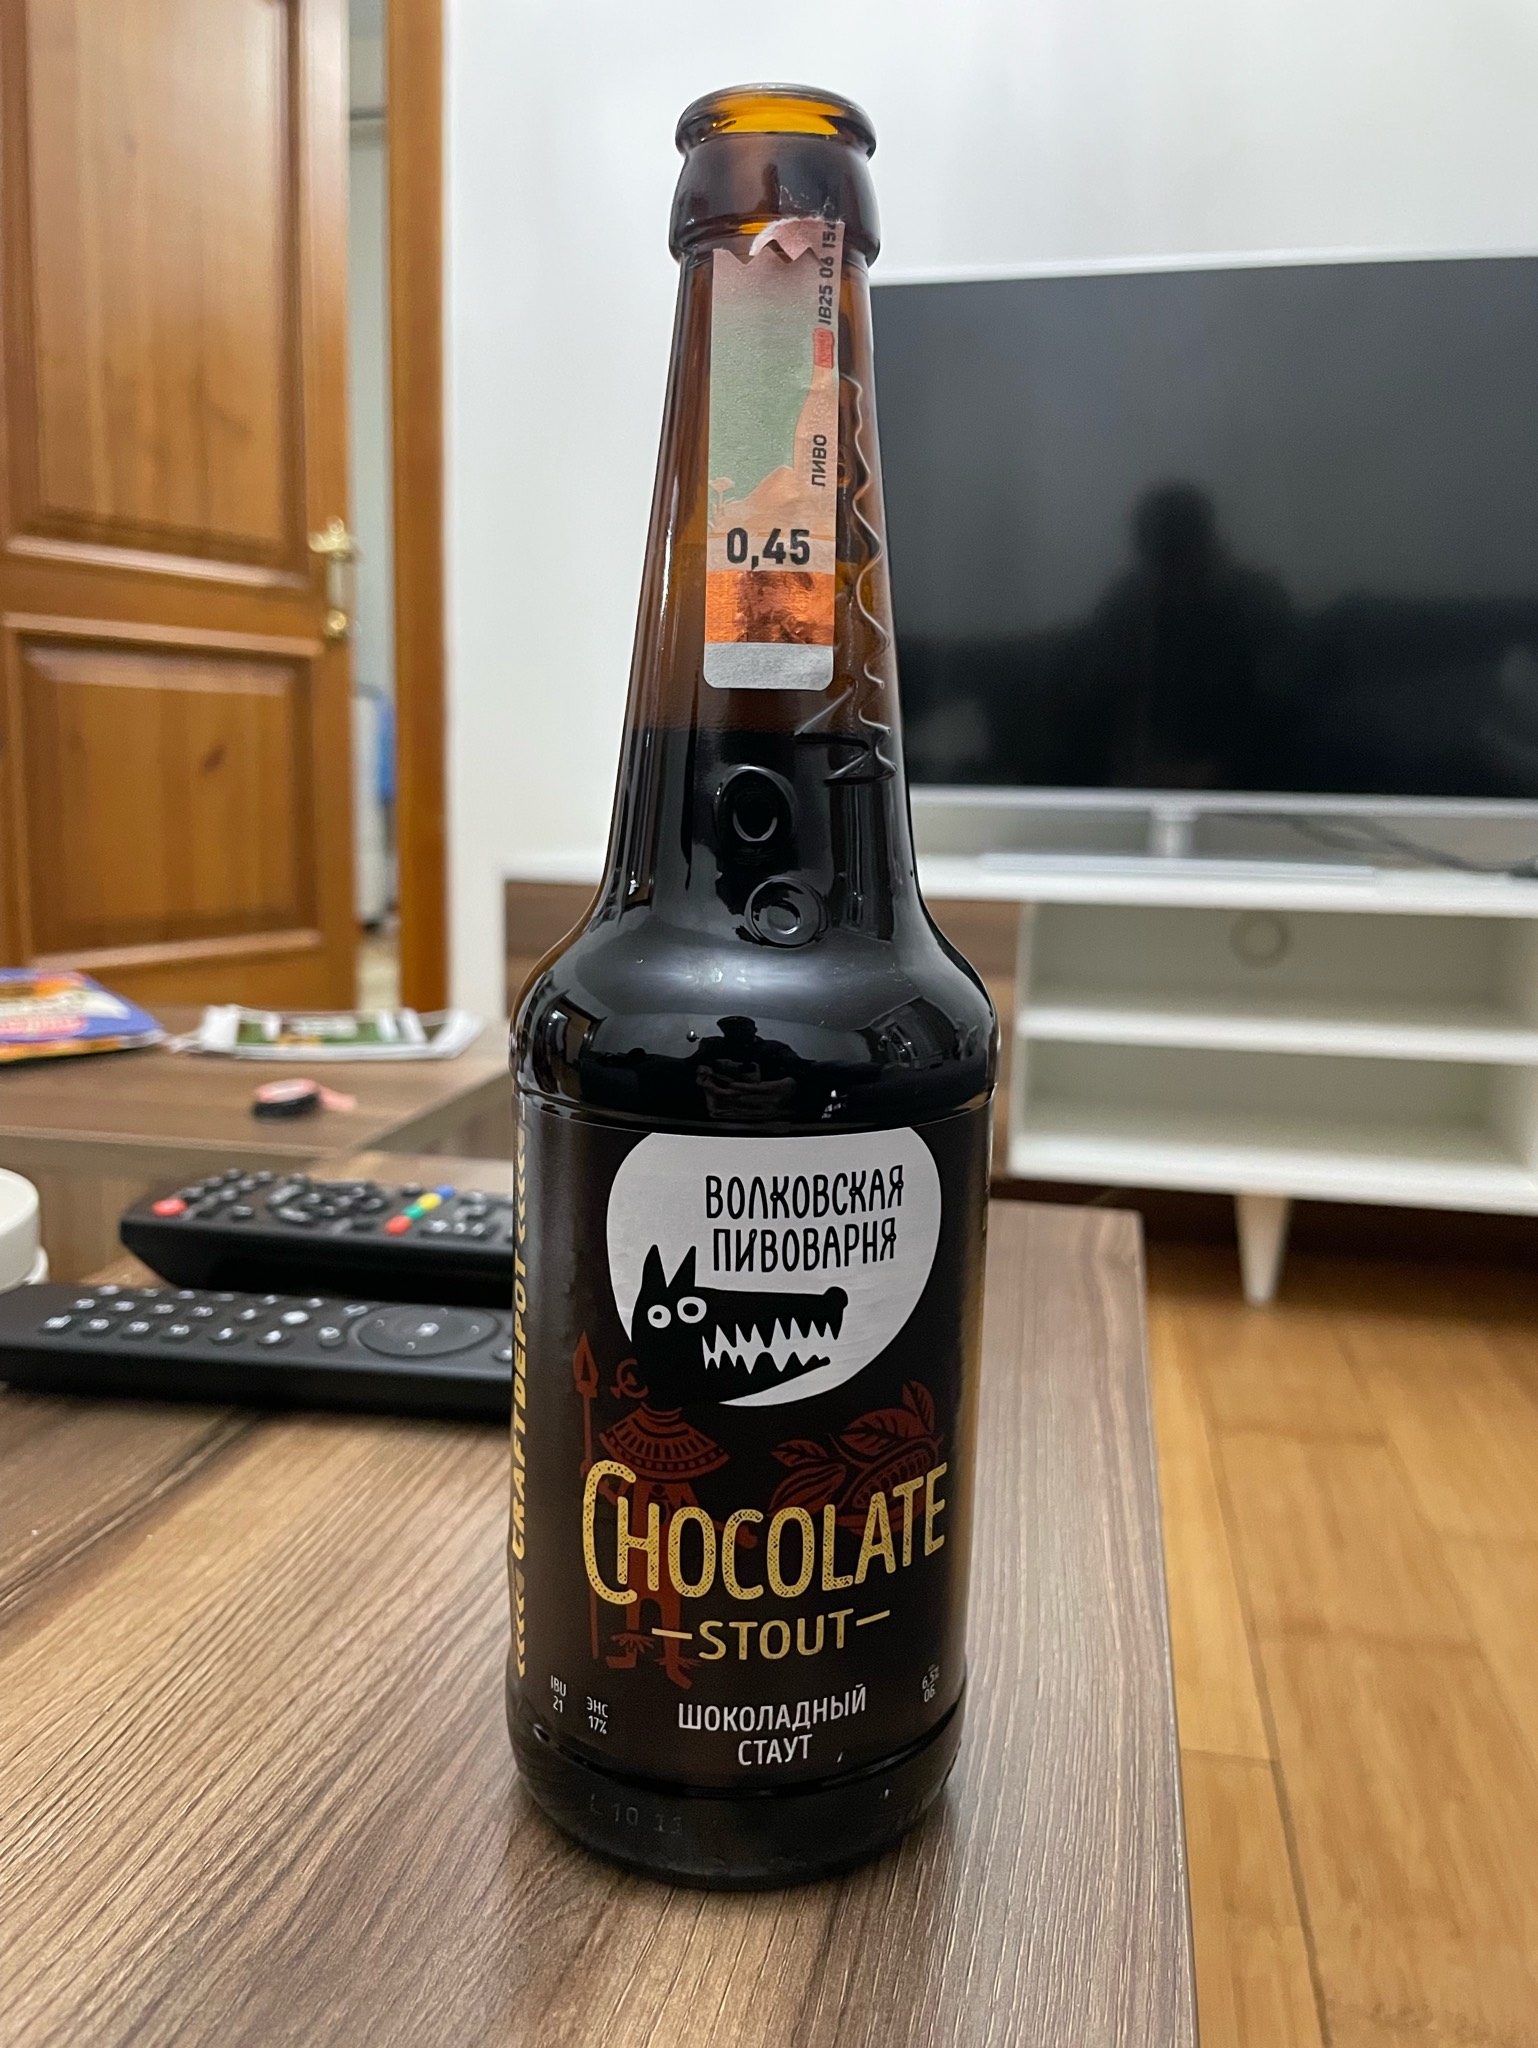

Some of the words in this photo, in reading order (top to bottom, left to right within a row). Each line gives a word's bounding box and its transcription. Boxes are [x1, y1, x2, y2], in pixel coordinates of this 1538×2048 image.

[811, 434, 828, 487] ПИВО
[725, 527, 811, 570] 0,45
[705, 1164, 904, 1220] ВОЛКОВСКАЯ
[712, 1216, 897, 1273] ПИВОВАРНЯ
[512, 1250, 526, 1560] CRAFTDEPOT
[550, 1674, 567, 1697] IBU
[553, 1695, 563, 1713] 21
[586, 1696, 609, 1718] ЭНС
[588, 1715, 607, 1735] 17%
[678, 1683, 867, 1732] ШОКОЛАДНЫЙ
[737, 1733, 813, 1766] СТАУТ
